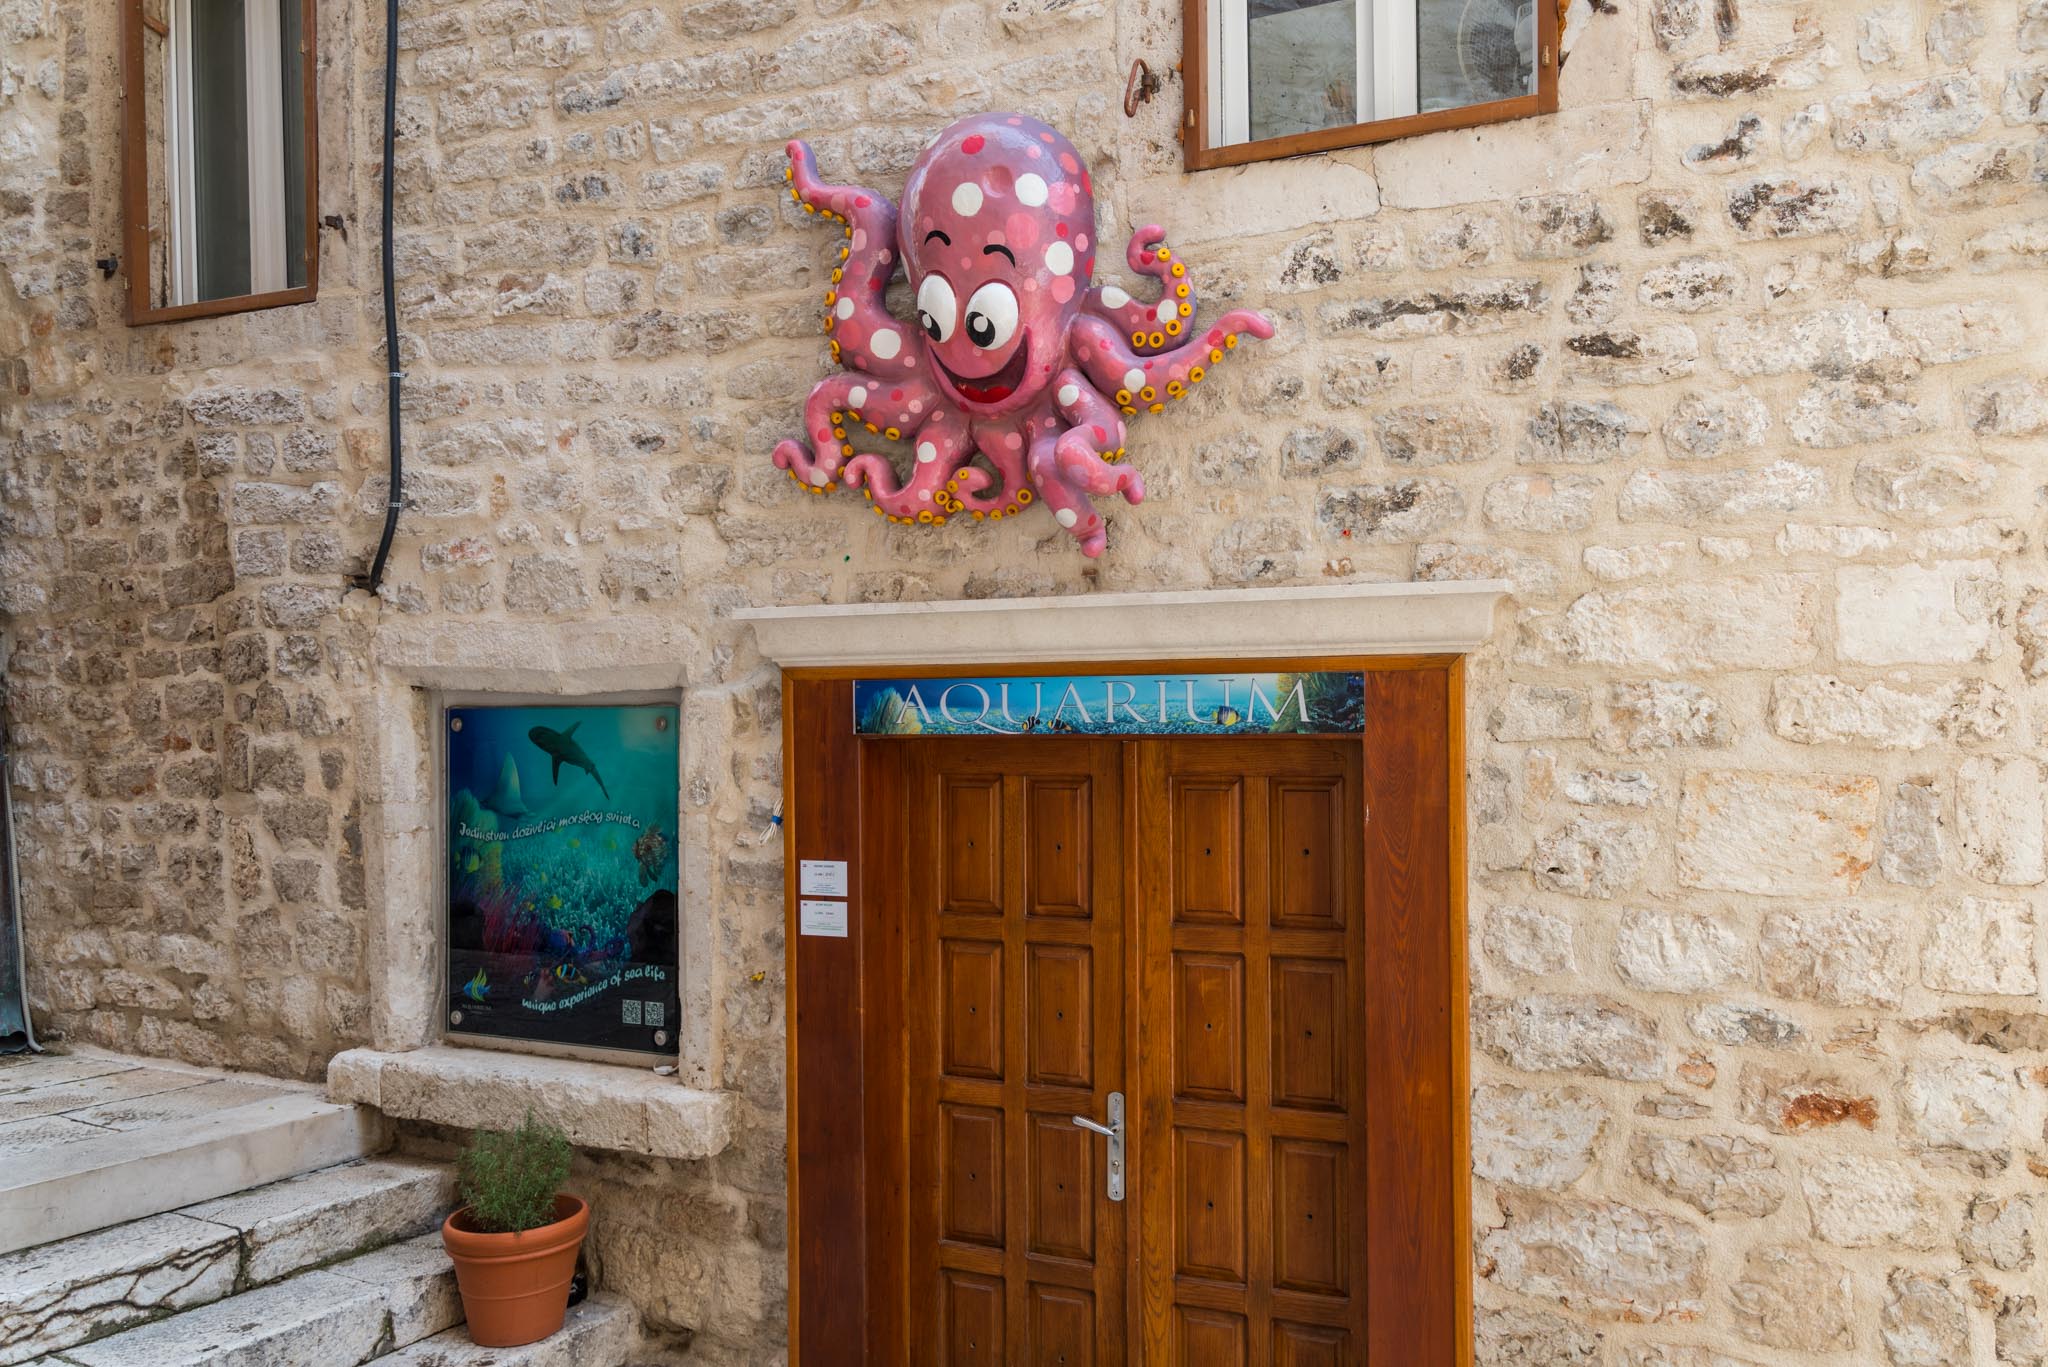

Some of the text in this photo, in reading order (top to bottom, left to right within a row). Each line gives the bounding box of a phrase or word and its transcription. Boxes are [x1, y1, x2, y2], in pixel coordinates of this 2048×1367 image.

[895, 677, 1313, 734] AQUARIUM
[559, 810, 603, 827] morskog
[606, 811, 640, 829] svijeta
[522, 965, 665, 1015] unique experience of sea life
